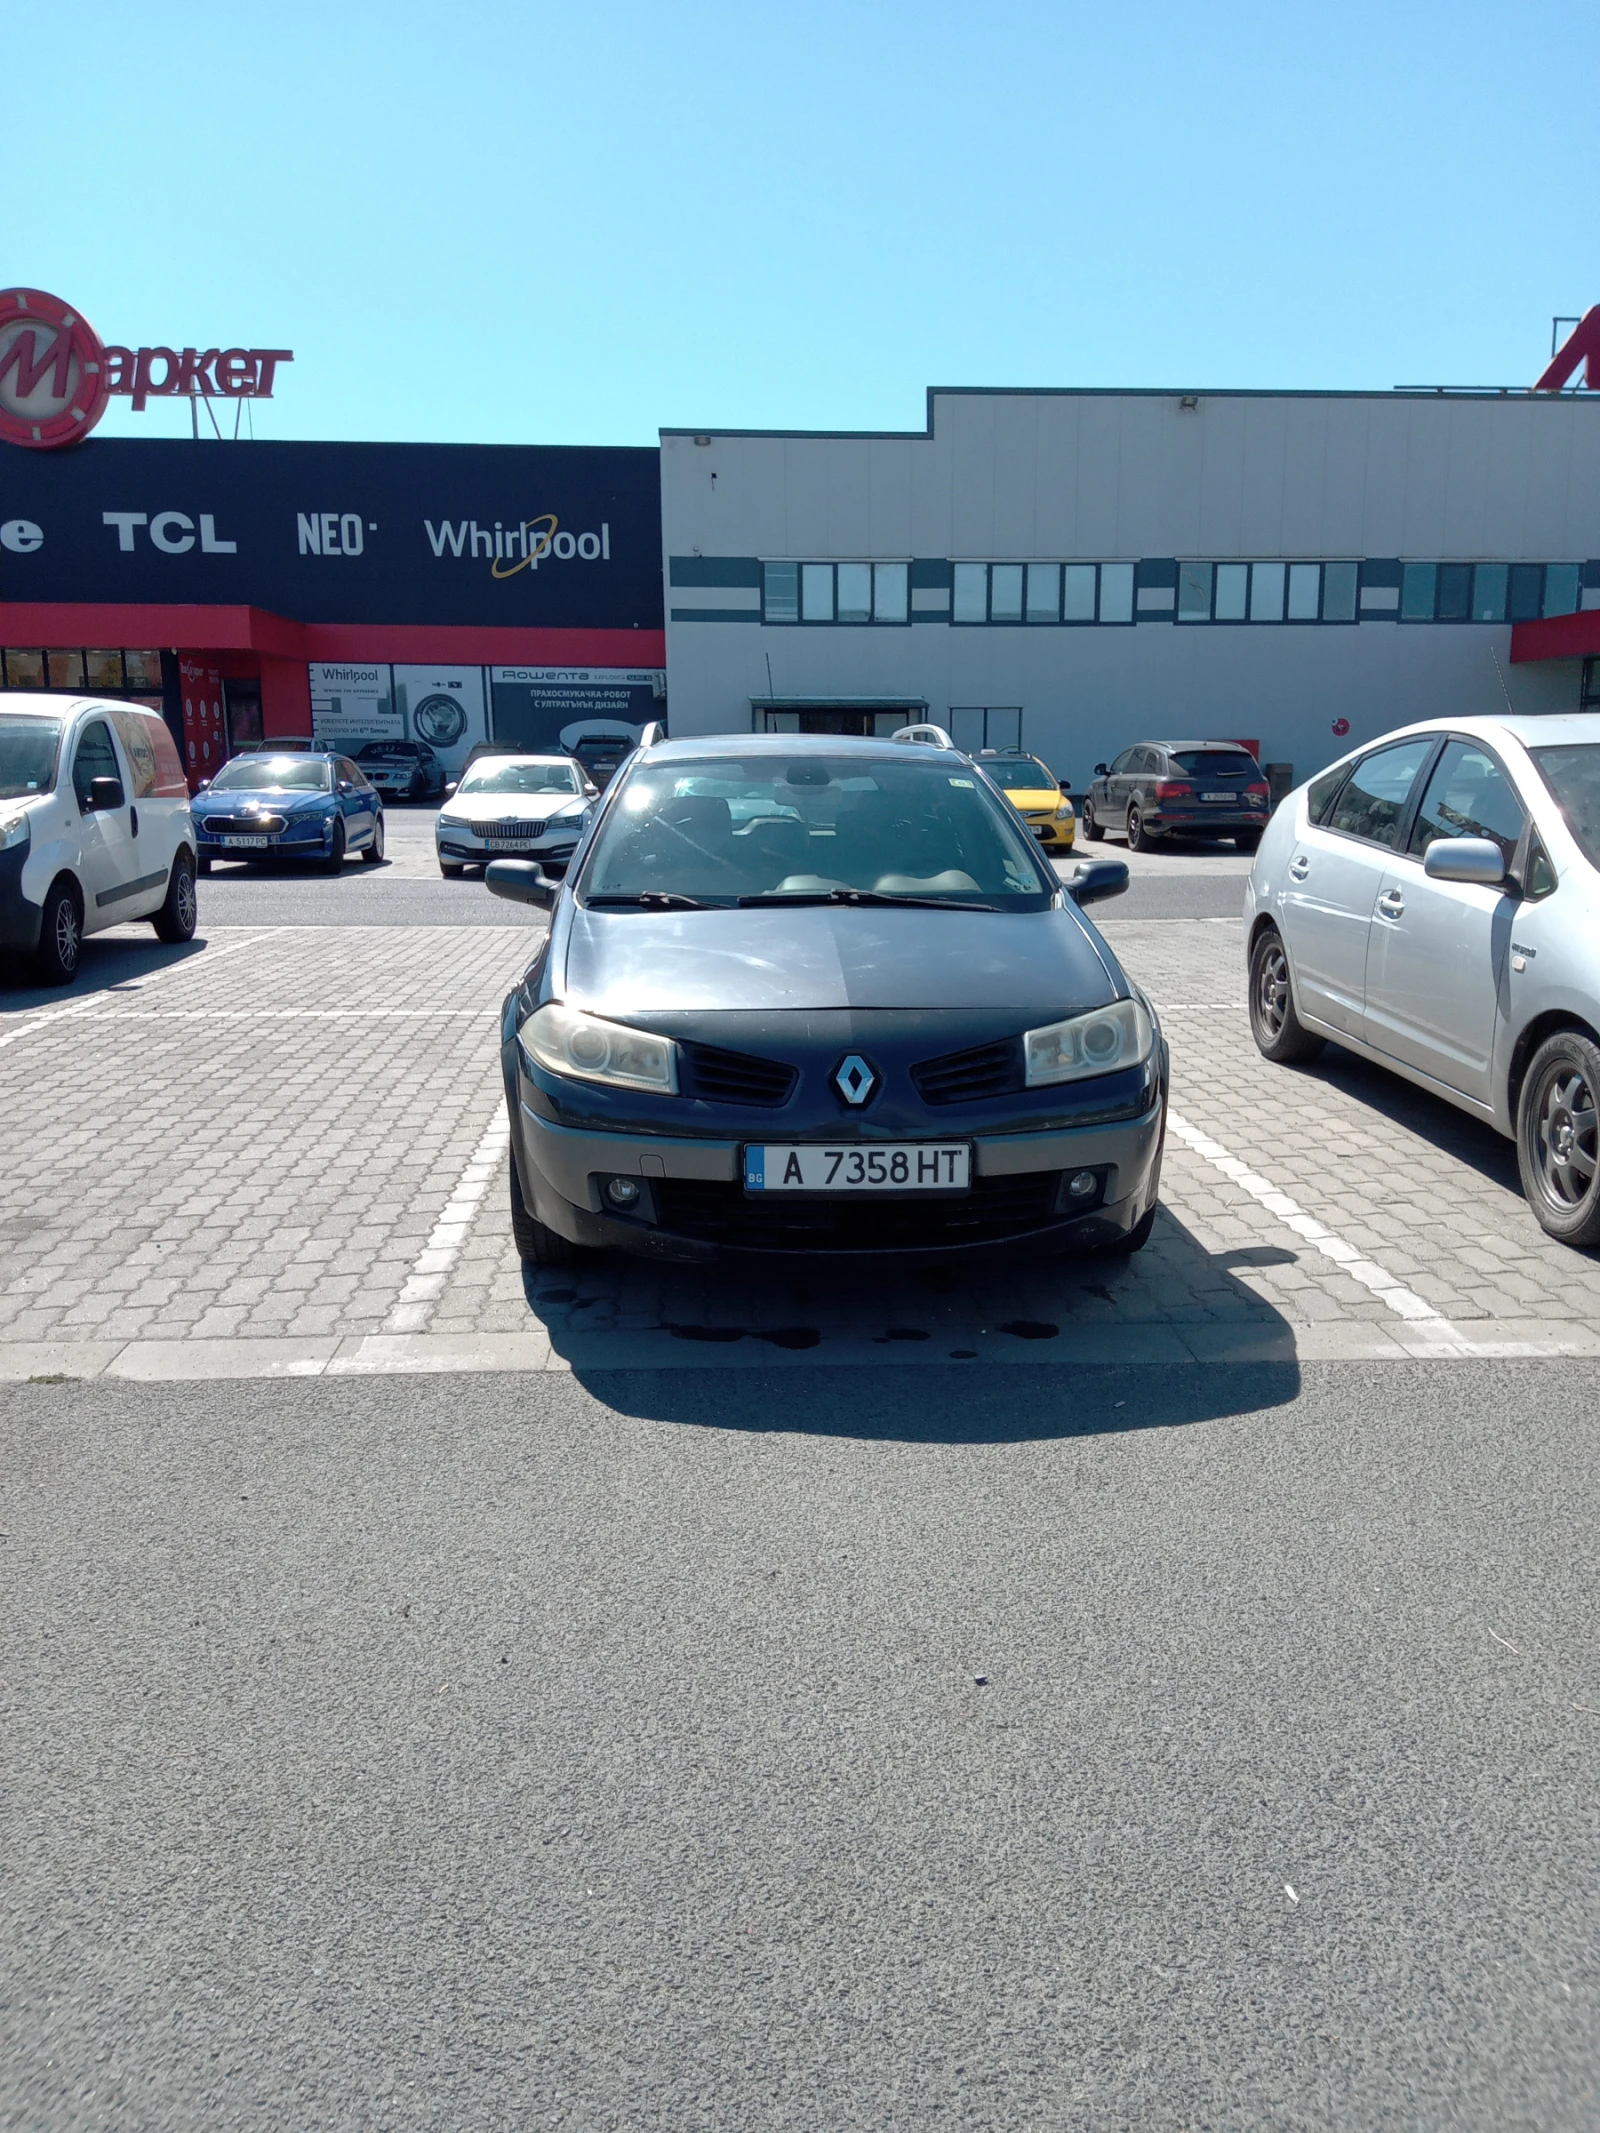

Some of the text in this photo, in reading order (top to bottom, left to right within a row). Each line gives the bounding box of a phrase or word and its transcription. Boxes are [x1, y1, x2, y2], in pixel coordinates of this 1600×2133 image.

[102, 511, 237, 554] TCL
[424, 519, 610, 570] Whirlpool
[322, 668, 378, 684] Whirlpool
[502, 670, 589, 680] Rowenta
[531, 689, 631, 698] ПРАХОСМУКАЧКА-РОБОТ
[541, 700, 594, 709] УЛТРАТЪНЪК
[594, 701, 629, 710] ДИЗАЙН
[748, 1150, 962, 1184] BG A 7358 HT
